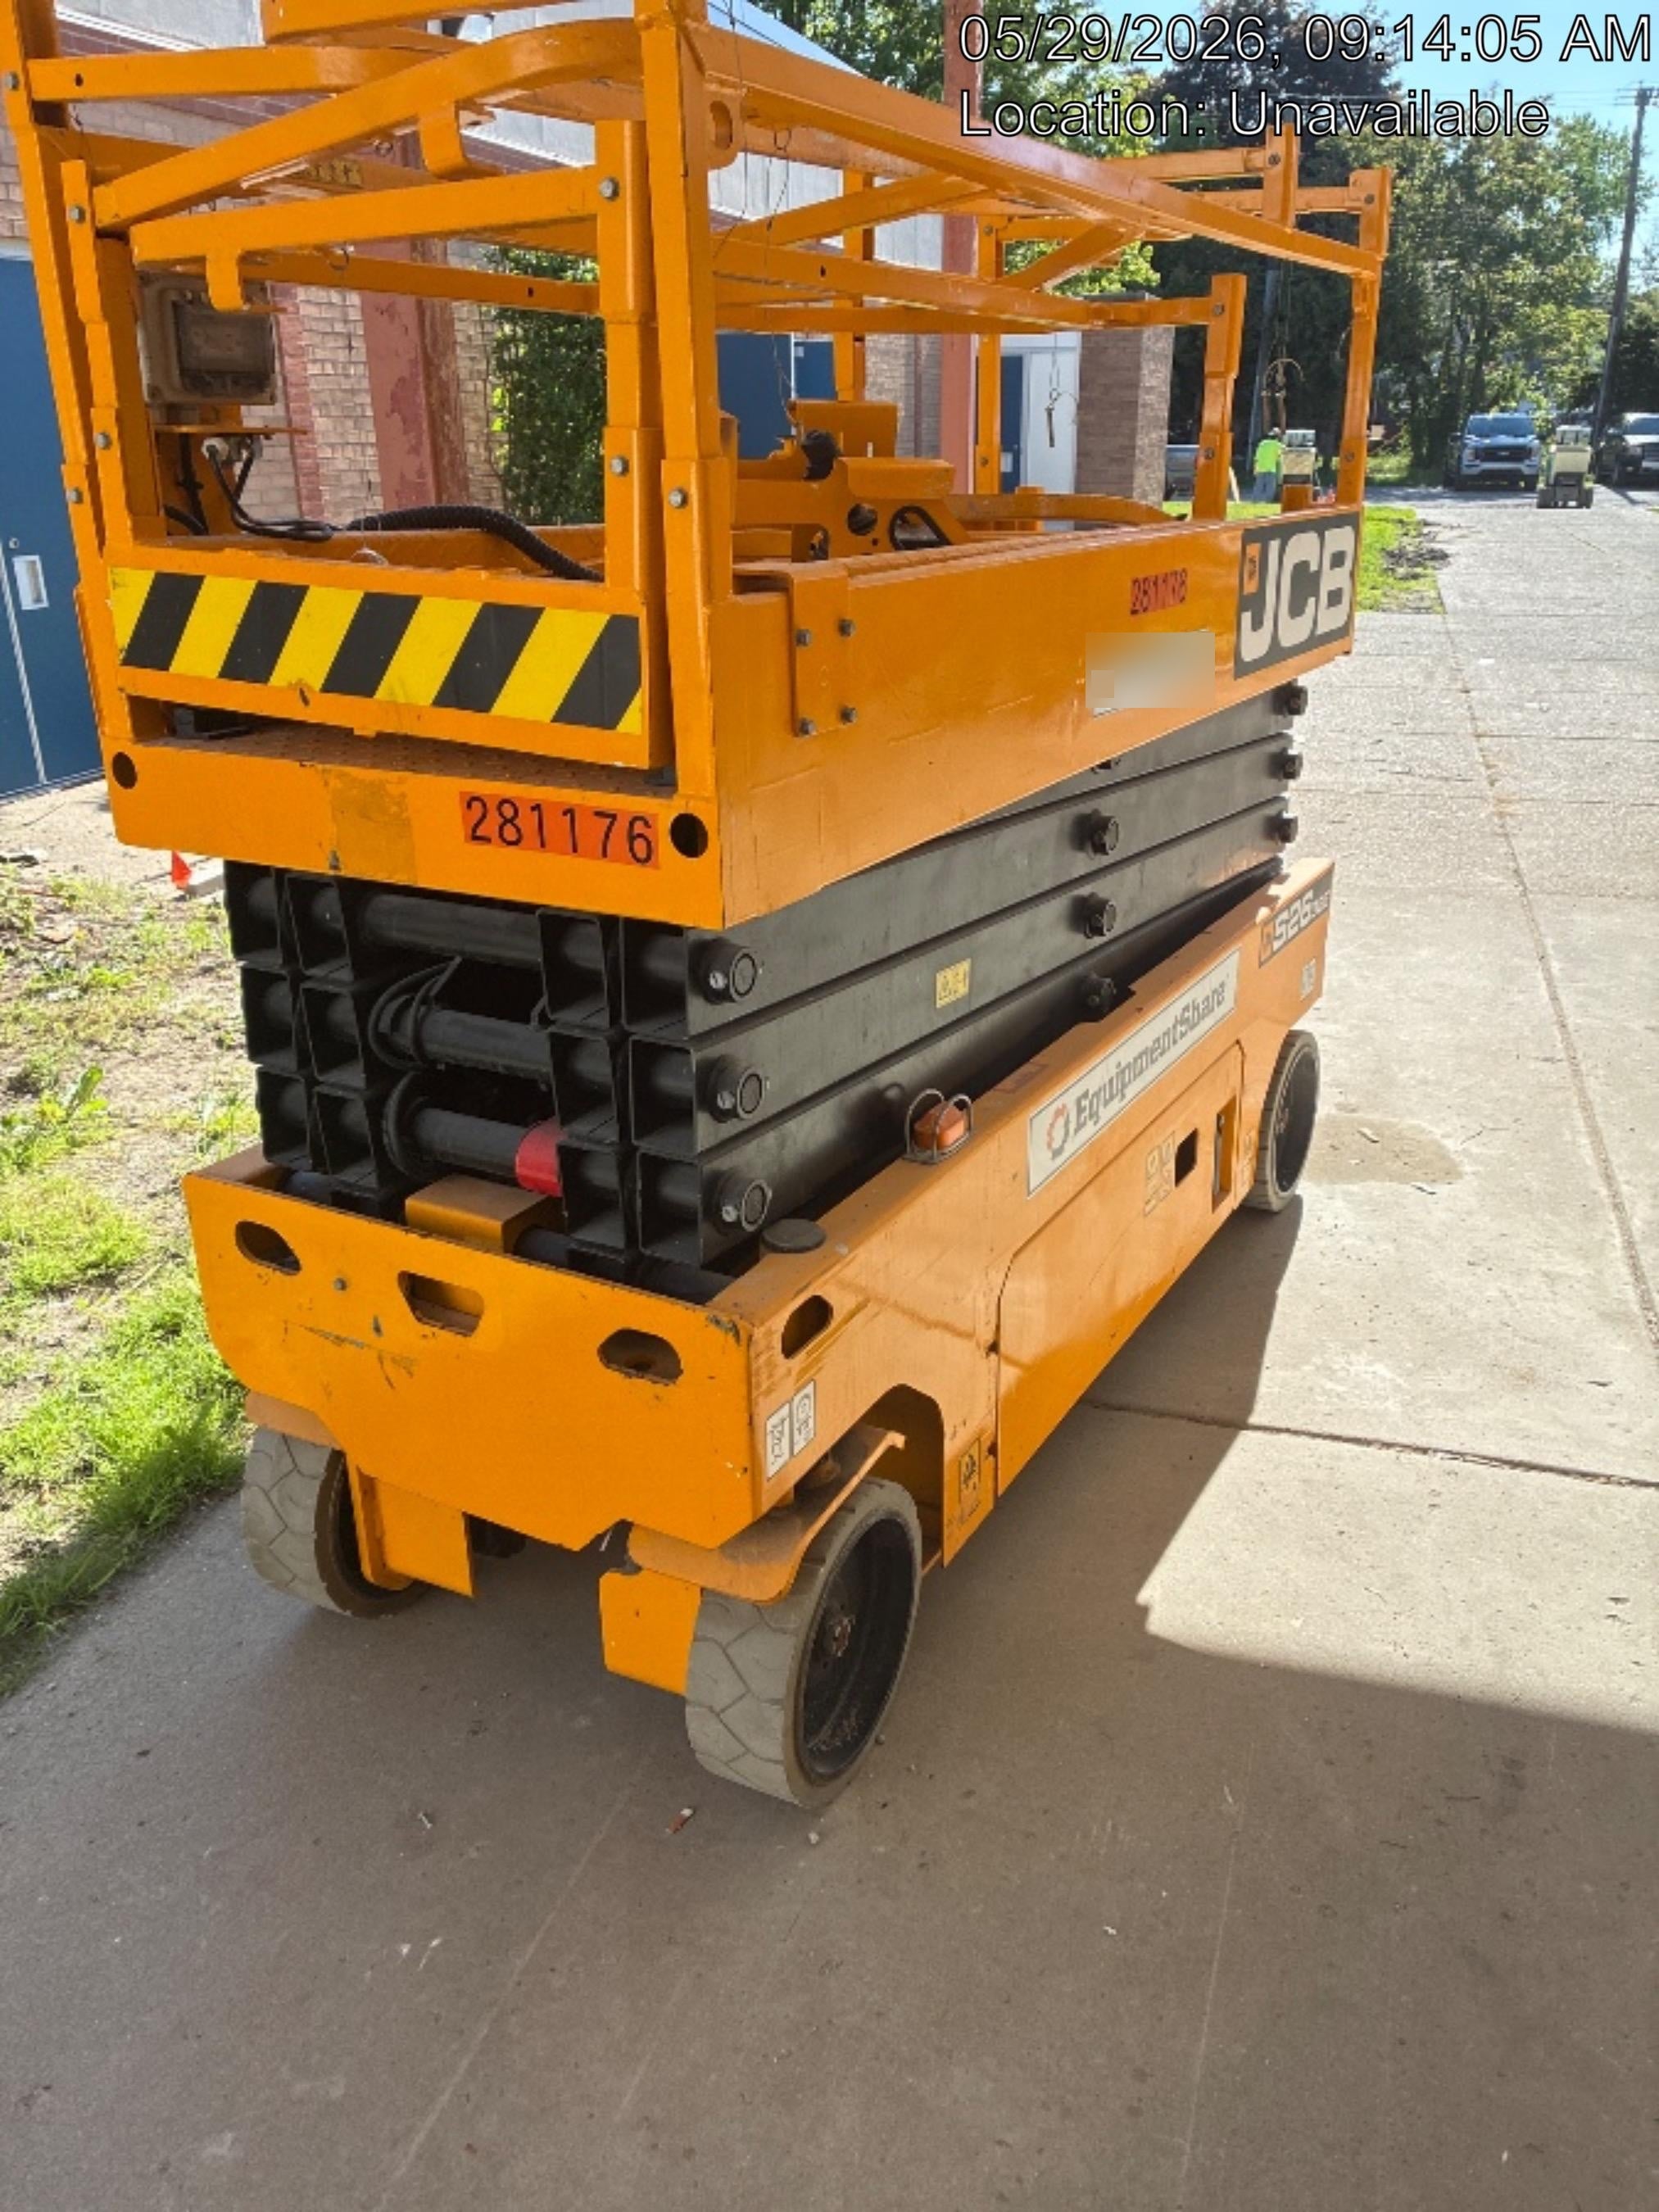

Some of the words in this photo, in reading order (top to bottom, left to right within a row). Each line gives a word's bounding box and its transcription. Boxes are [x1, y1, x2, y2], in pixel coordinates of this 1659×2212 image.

[1240, 526, 1355, 662] JCB
[466, 796, 652, 865] 281176
[1074, 981, 1226, 1136] EquipmentShare
